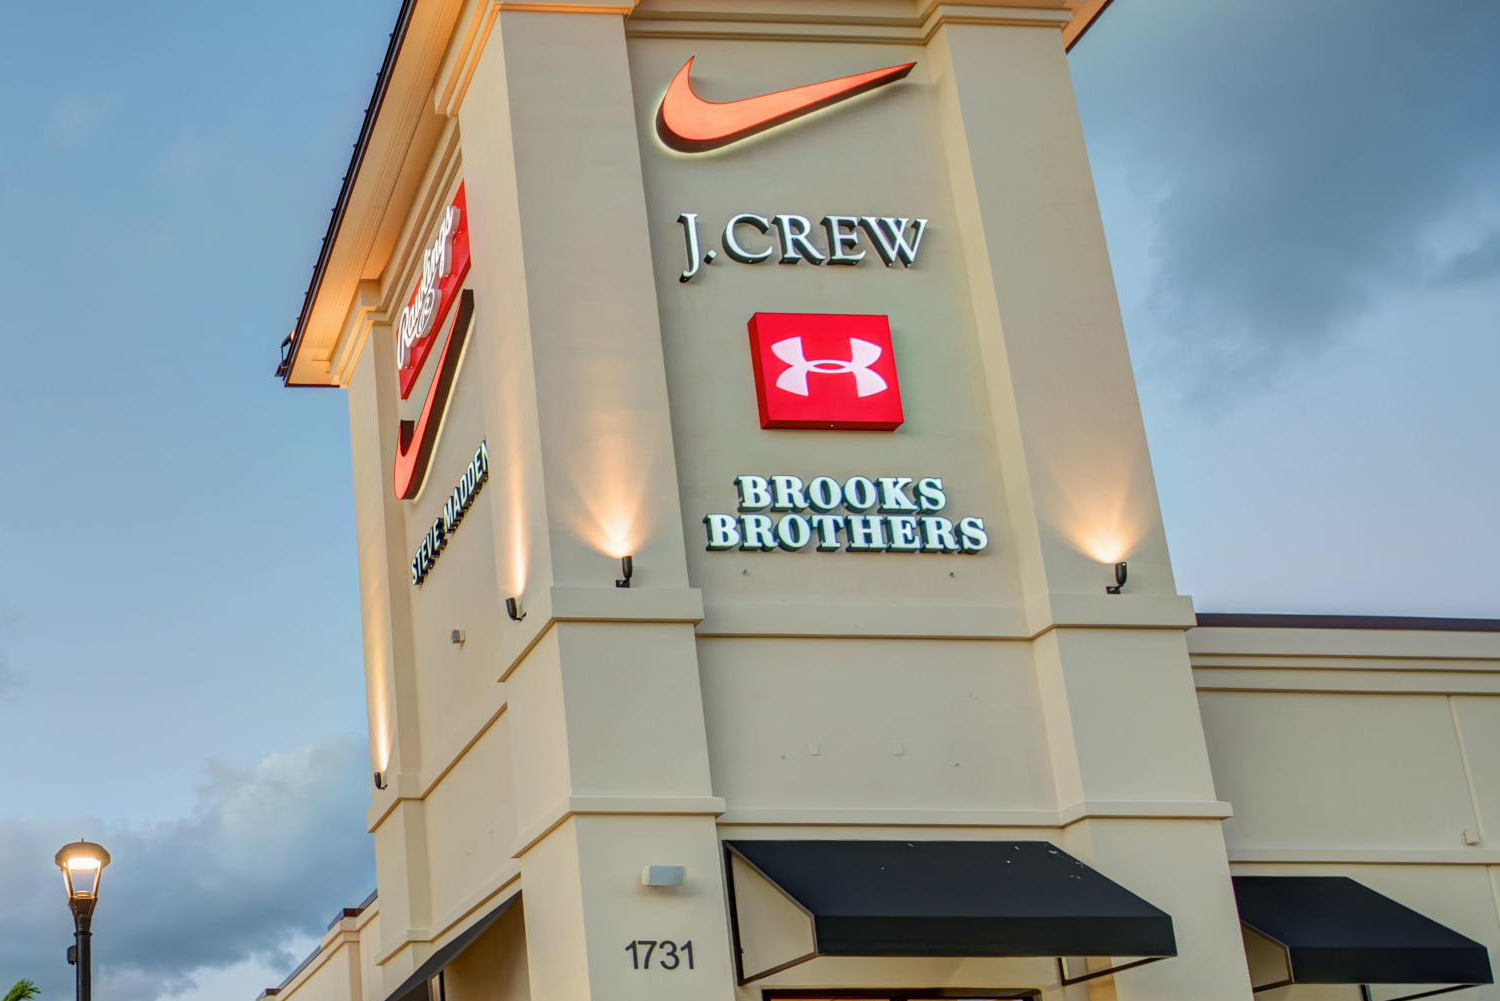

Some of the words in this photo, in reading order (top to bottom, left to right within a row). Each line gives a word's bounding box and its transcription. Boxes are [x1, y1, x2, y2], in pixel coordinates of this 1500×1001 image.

[411, 517, 445, 585] STEVE
[443, 440, 488, 534] MADDEN
[734, 475, 948, 514] BROOKS
[704, 512, 988, 554] BROTHERS
[625, 940, 694, 970] 1731
